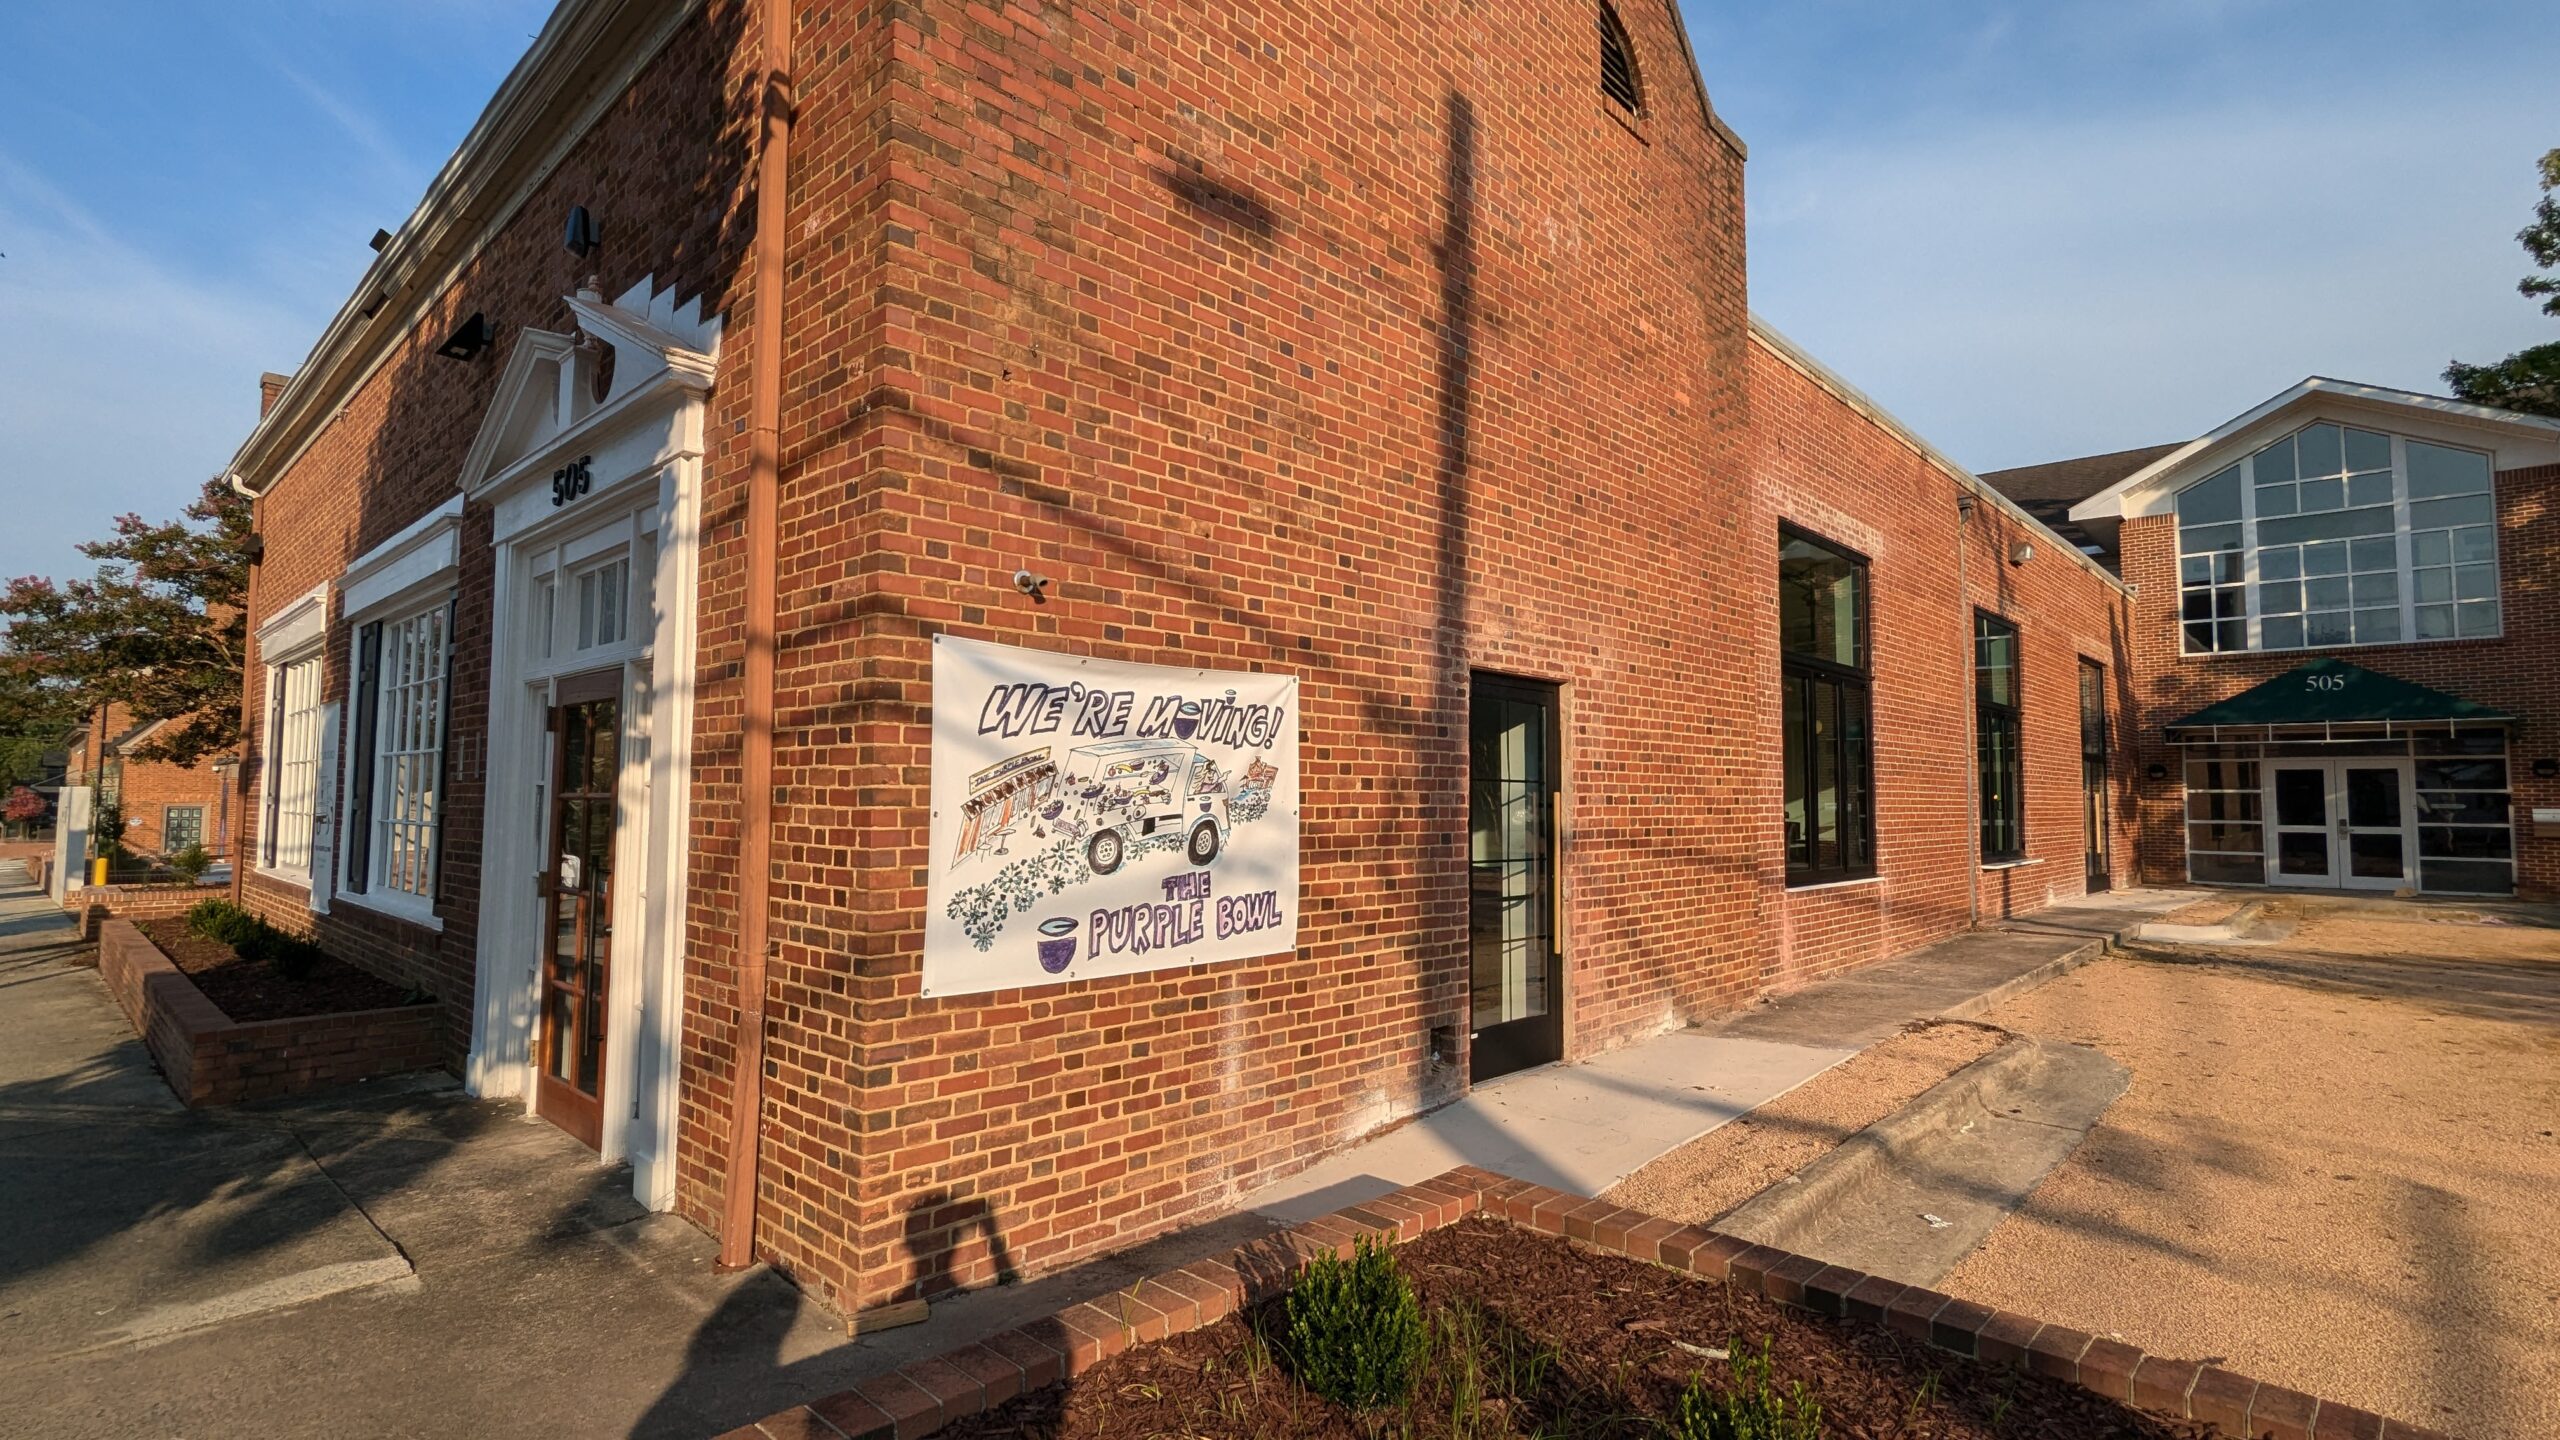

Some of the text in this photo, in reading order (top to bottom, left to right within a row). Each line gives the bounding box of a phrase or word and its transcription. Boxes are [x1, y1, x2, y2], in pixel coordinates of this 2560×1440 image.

[551, 455, 592, 507] 505
[2305, 674, 2345, 692] 505
[978, 681, 1285, 750] WE'RE MOVING!
[1161, 871, 1211, 902] THE
[1087, 890, 1283, 961] PURPLE BOWL
